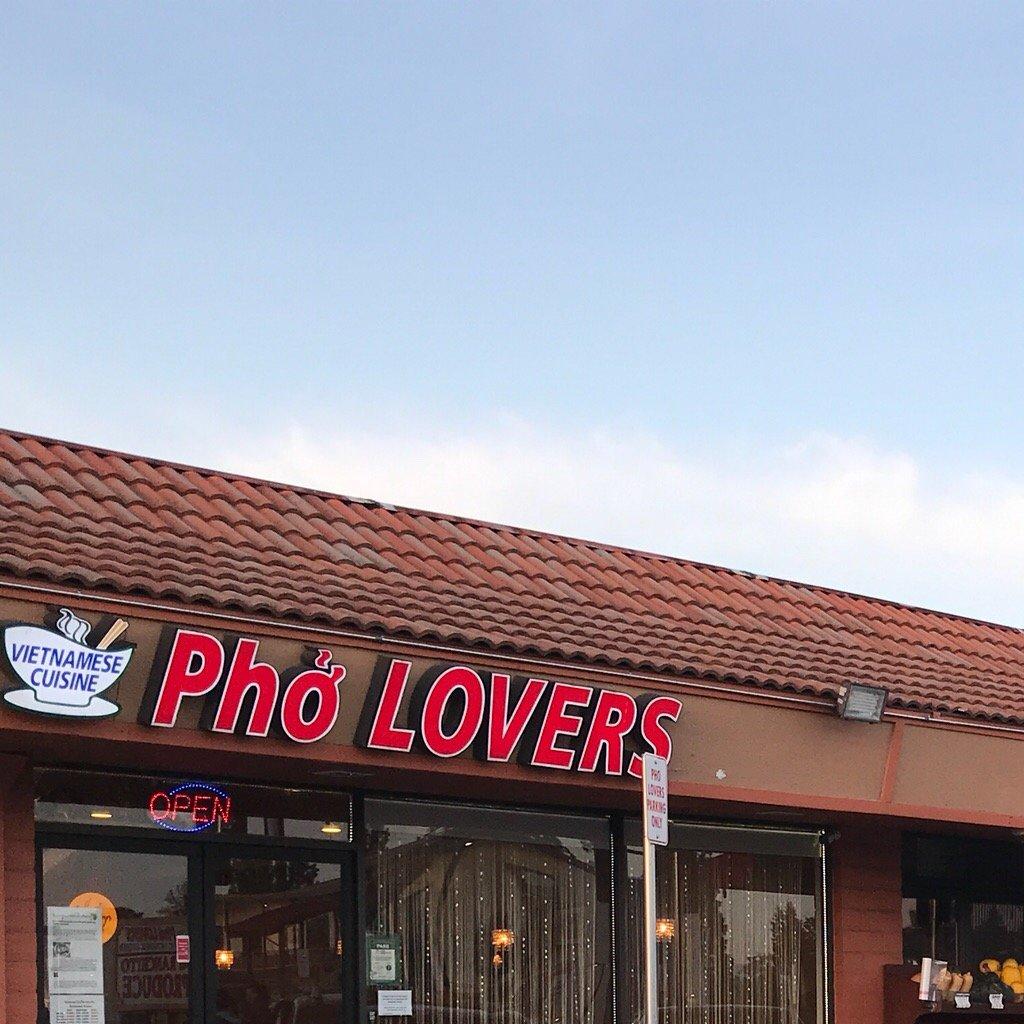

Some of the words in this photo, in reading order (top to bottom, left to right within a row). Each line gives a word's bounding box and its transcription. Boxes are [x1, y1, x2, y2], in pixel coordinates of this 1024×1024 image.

[12, 643, 124, 675] VIETNAMESE
[30, 668, 100, 693] CUISINE
[367, 659, 683, 778] LOVERS
[650, 768, 661, 781] PHO
[648, 783, 665, 798] LOVERS
[149, 792, 232, 824] OPEN
[647, 798, 667, 814] PARKING
[651, 815, 662, 829] ONLY
